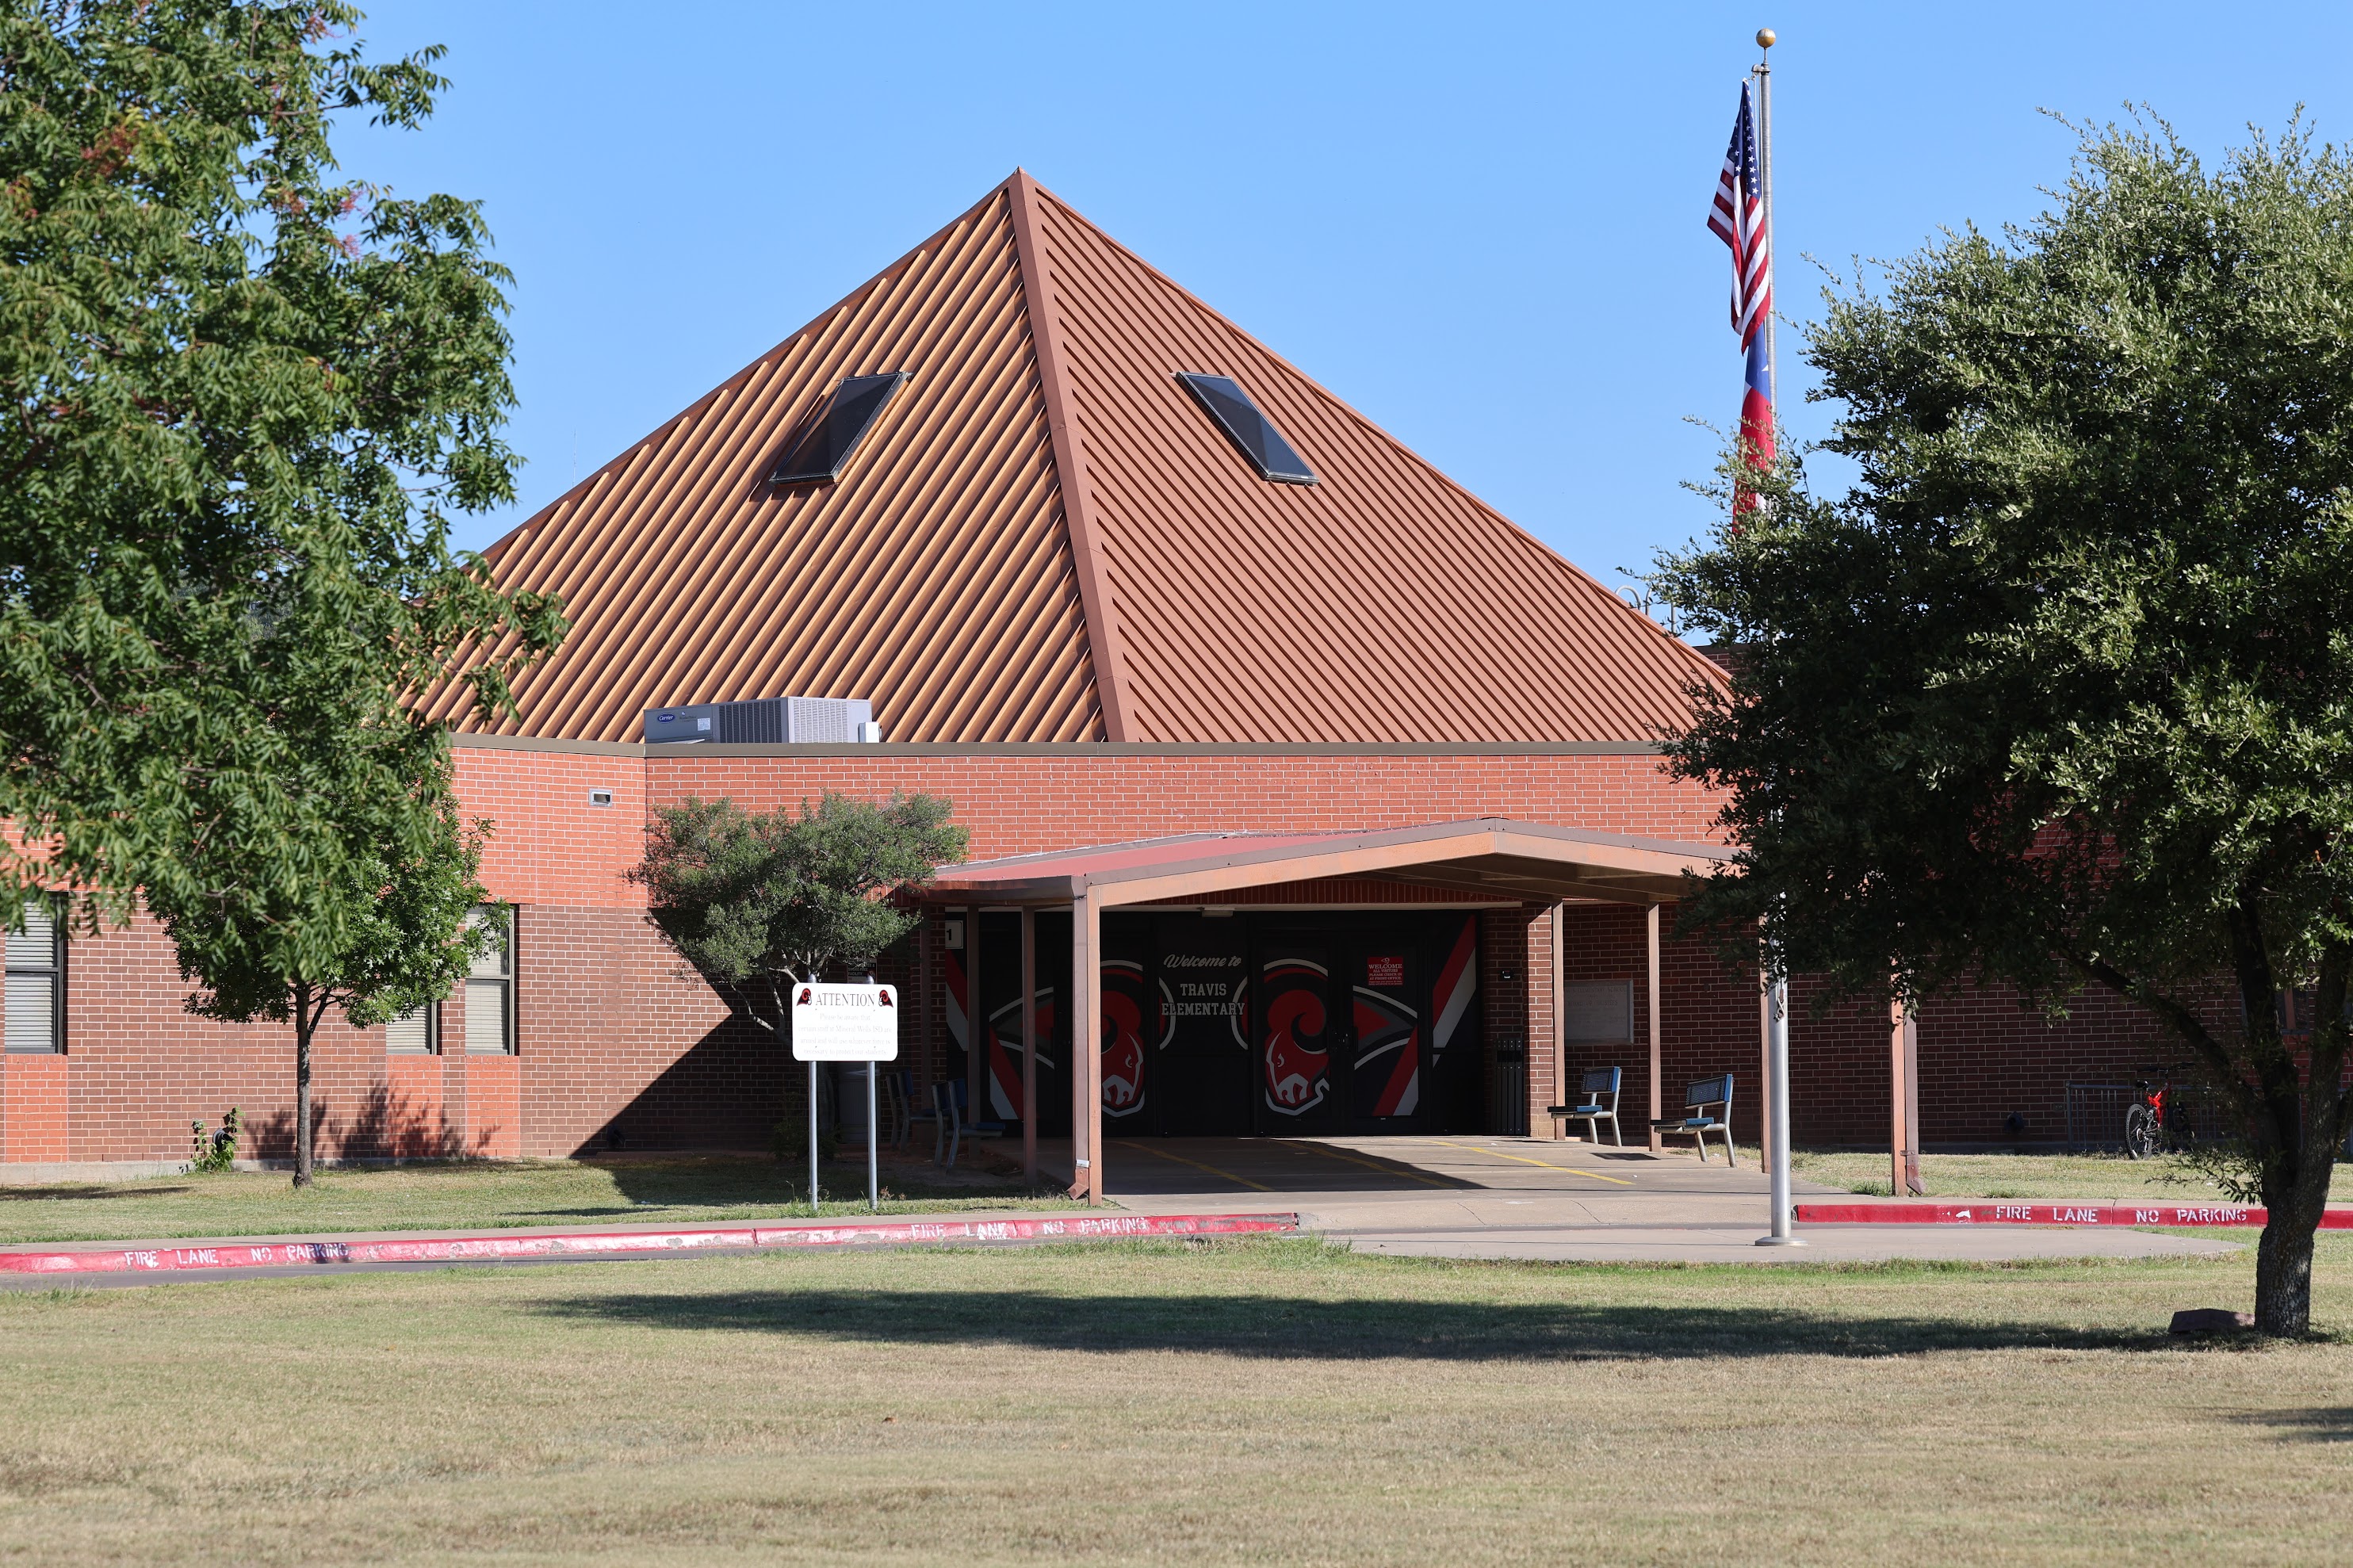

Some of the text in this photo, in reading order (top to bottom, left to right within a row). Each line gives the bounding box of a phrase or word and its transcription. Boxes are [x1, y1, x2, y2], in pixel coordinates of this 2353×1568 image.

[1163, 954, 1242, 969] Welcome to
[1180, 983, 1226, 996] TRAVIS
[815, 992, 875, 1007] ATTENTION
[1161, 1002, 1245, 1015] ELEMENTARY
[820, 1012, 836, 1021] Please
[836, 1024, 856, 1033] Mineral
[856, 1024, 871, 1033] Wells
[836, 1049, 854, 1057] protect
[1996, 1206, 2247, 1223] FIRE LANE NO PARKING
[911, 1217, 1148, 1238] FIRE LANE NO PARKING
[124, 1242, 350, 1267] FIRE LANE NO PARKING
